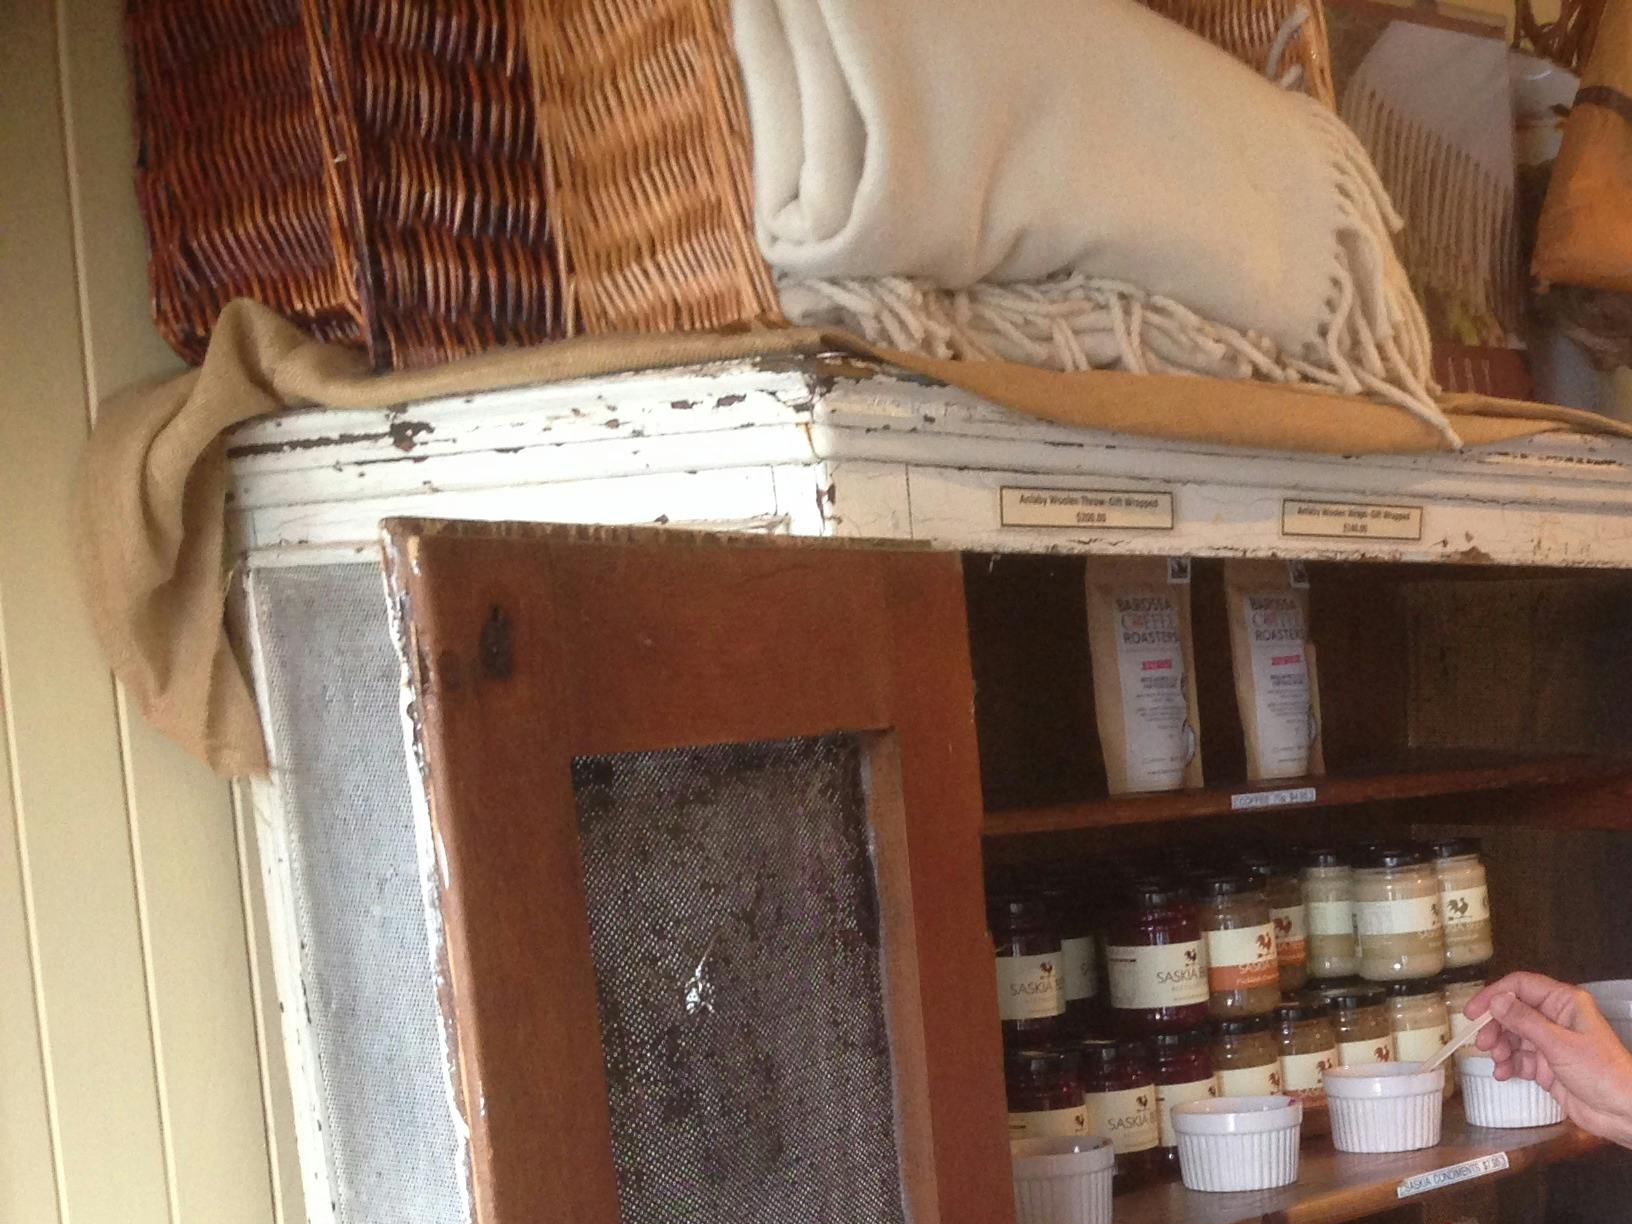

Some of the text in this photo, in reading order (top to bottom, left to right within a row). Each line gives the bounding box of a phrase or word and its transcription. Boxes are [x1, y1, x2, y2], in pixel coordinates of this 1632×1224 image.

[1156, 965, 1199, 985] SASKIA
[1010, 979, 1053, 996] SASKIA
[1107, 1113, 1150, 1131] SASKIA
